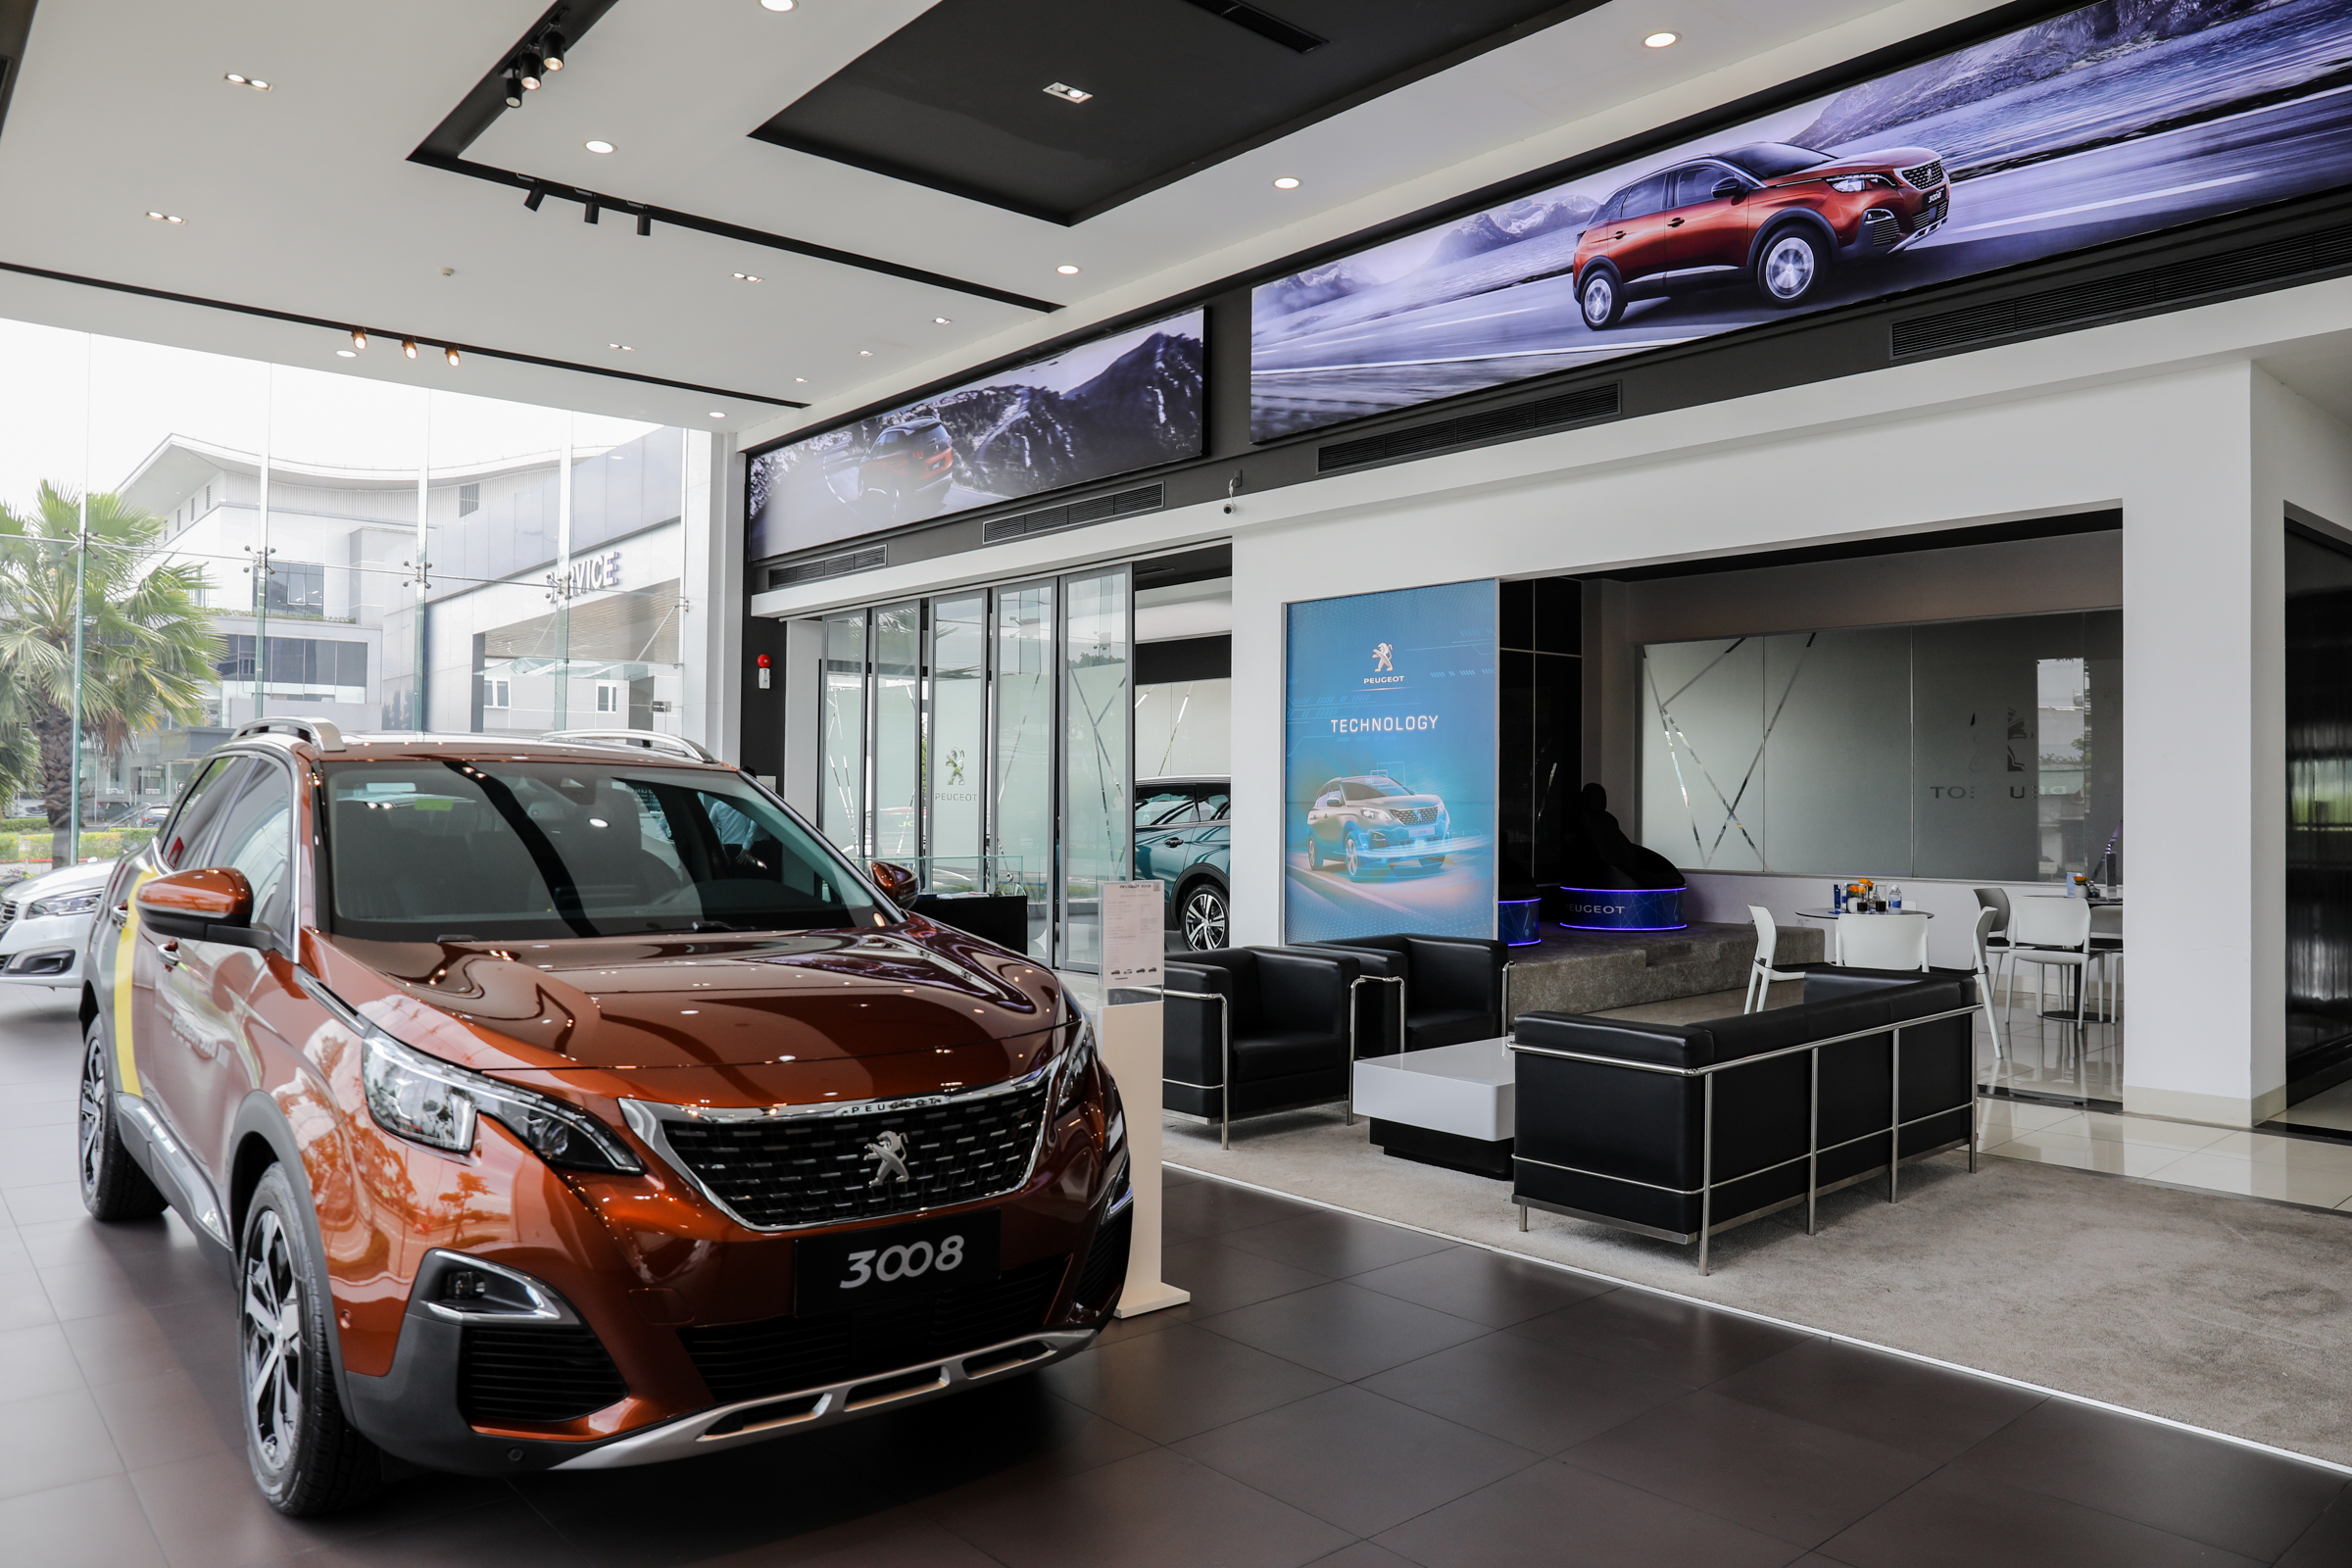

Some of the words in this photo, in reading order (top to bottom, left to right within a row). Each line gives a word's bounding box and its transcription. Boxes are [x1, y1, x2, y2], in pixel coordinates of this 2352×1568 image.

[544, 551, 619, 604] SRVICE
[1363, 675, 1404, 684] PEUGEOT
[1331, 715, 1438, 733] TECHNOLOGY
[934, 793, 978, 802] PEUGEOT
[852, 1098, 936, 1113] PEUGEOT
[840, 1235, 964, 1289] 3008
